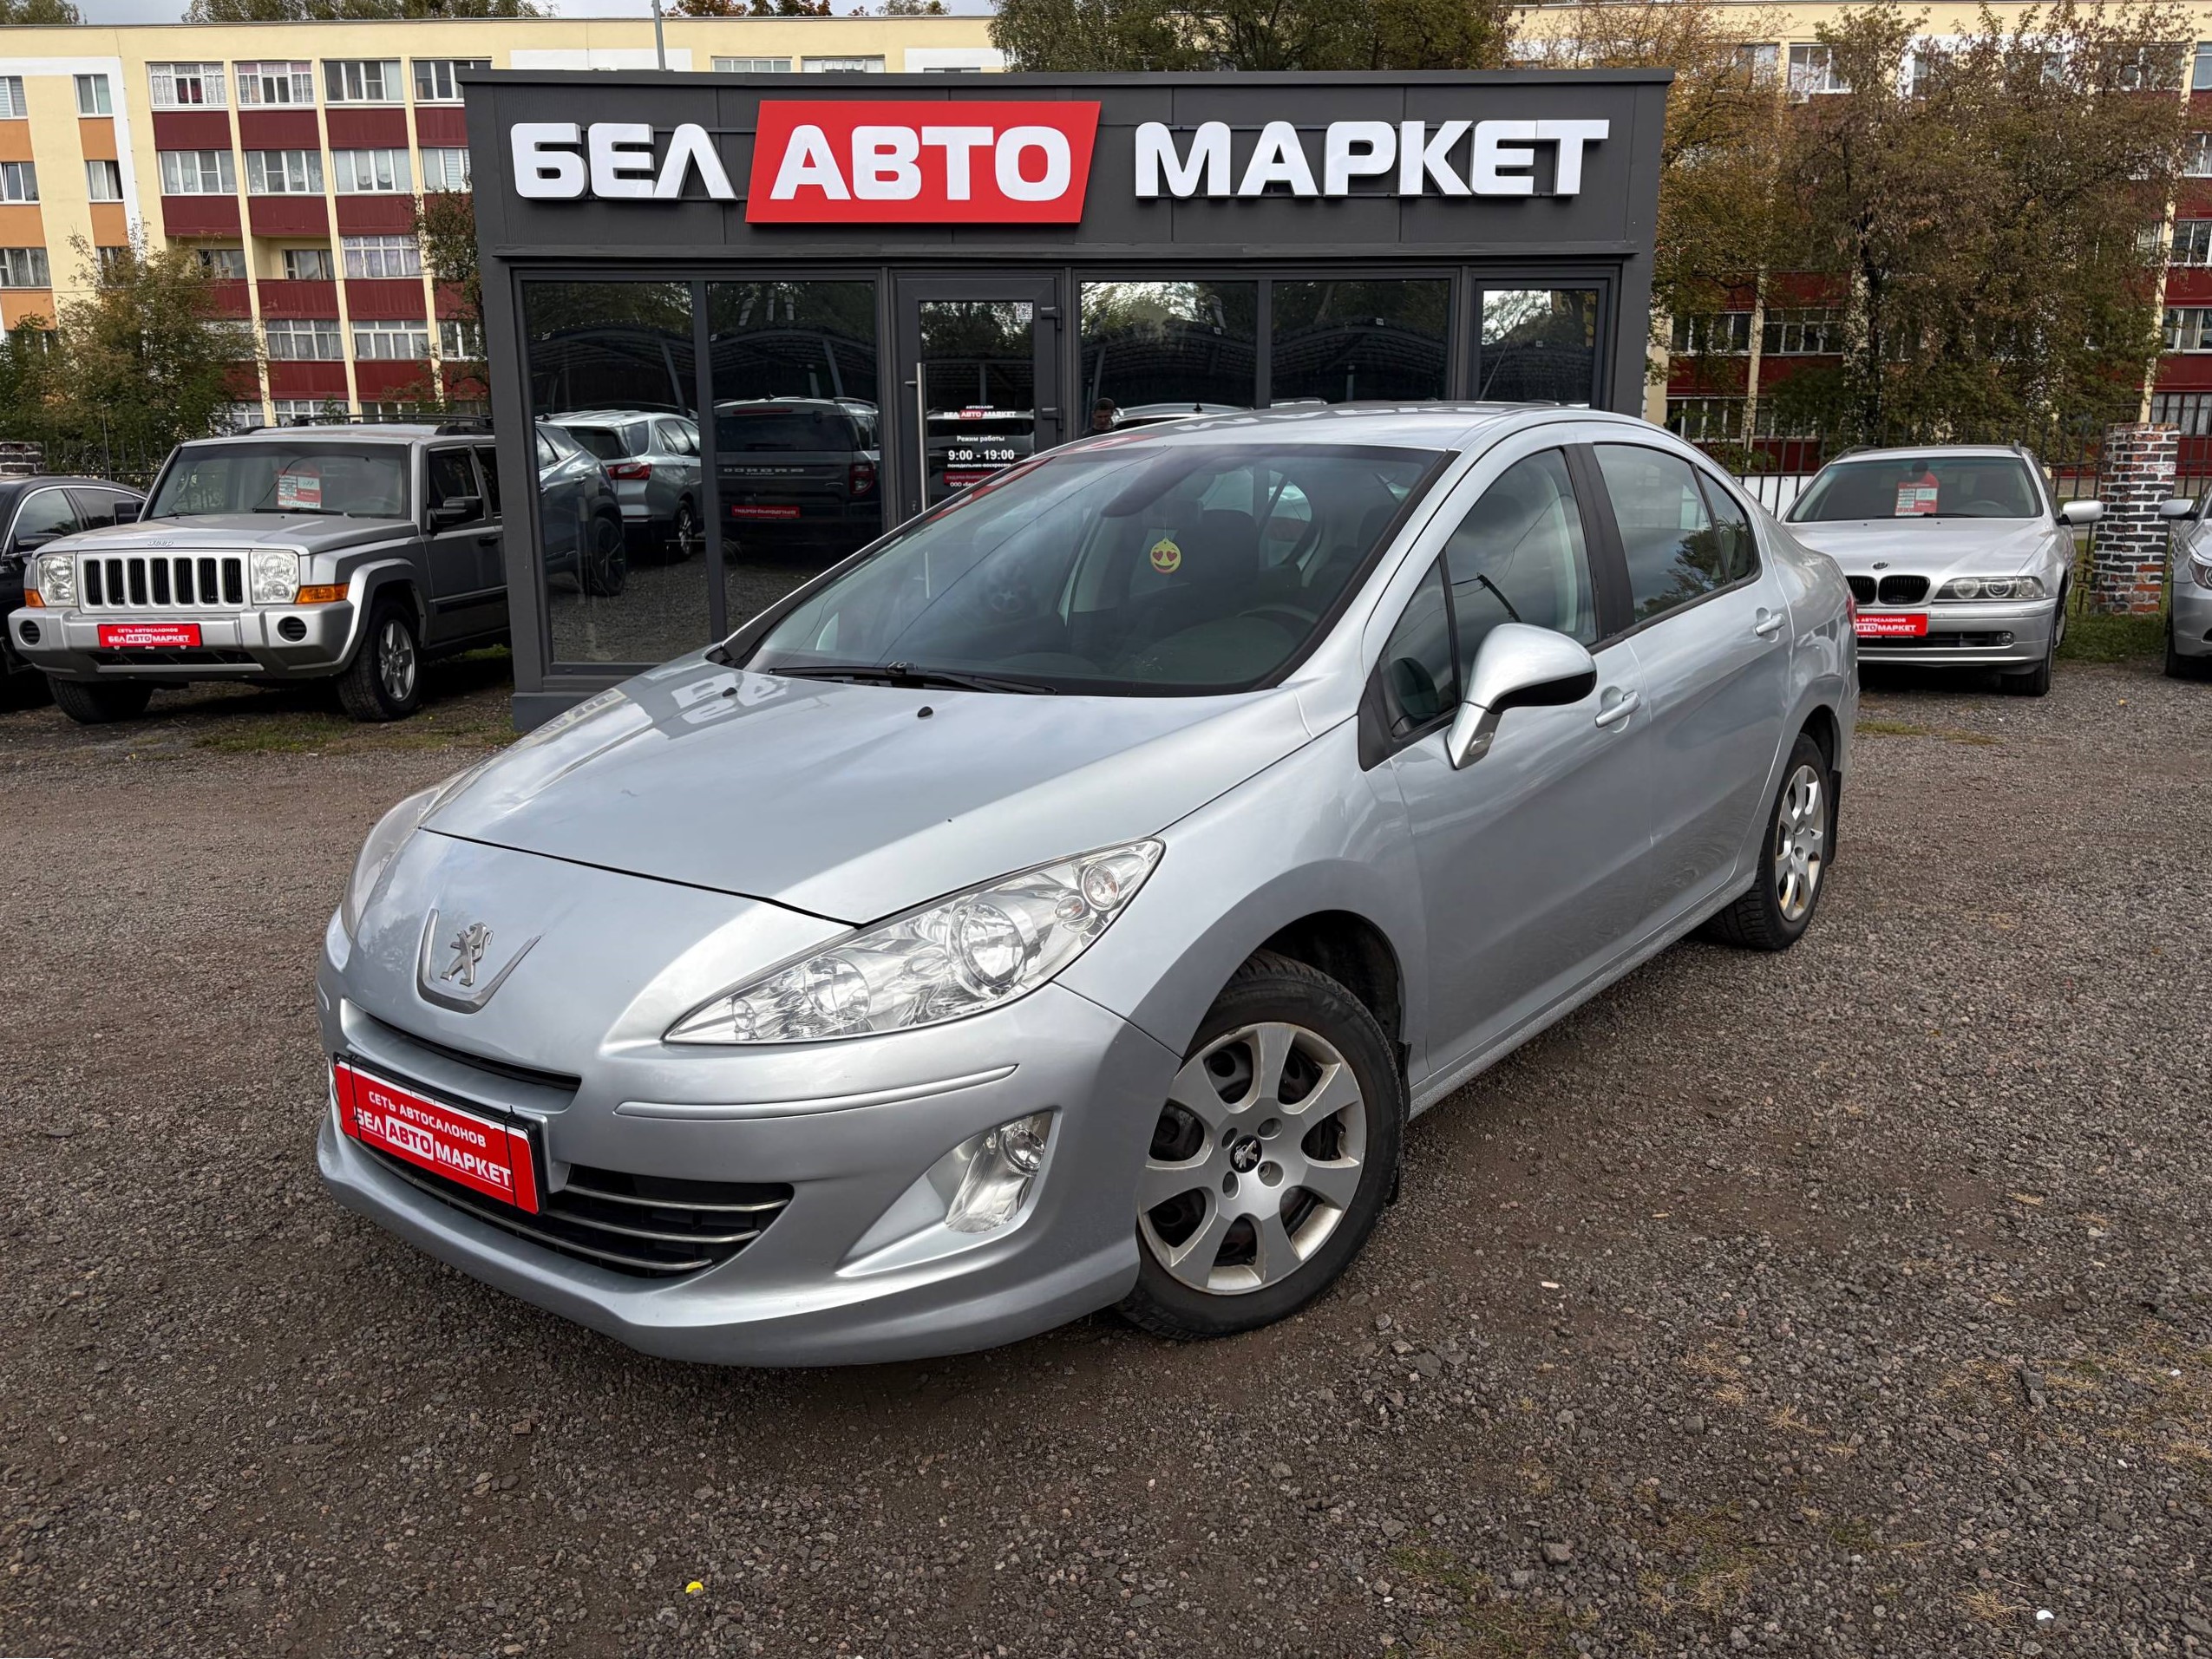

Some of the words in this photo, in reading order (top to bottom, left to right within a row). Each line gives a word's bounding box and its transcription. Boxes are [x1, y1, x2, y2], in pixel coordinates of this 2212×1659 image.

[510, 122, 738, 200] БЕЛ
[769, 124, 1071, 201] АВТО
[1135, 120, 1610, 199] МАРКЕТ
[948, 450, 973, 460] 9:00
[983, 449, 1015, 460] 19:00
[979, 434, 1005, 443] работы
[354, 1106, 385, 1135] БЕЛ
[388, 1120, 432, 1155] АВТО
[435, 1141, 512, 1187] МАРКЕТ
[369, 1091, 396, 1112] СЕТЬ
[399, 1101, 487, 1148] АВТОСАЛОНОВ
